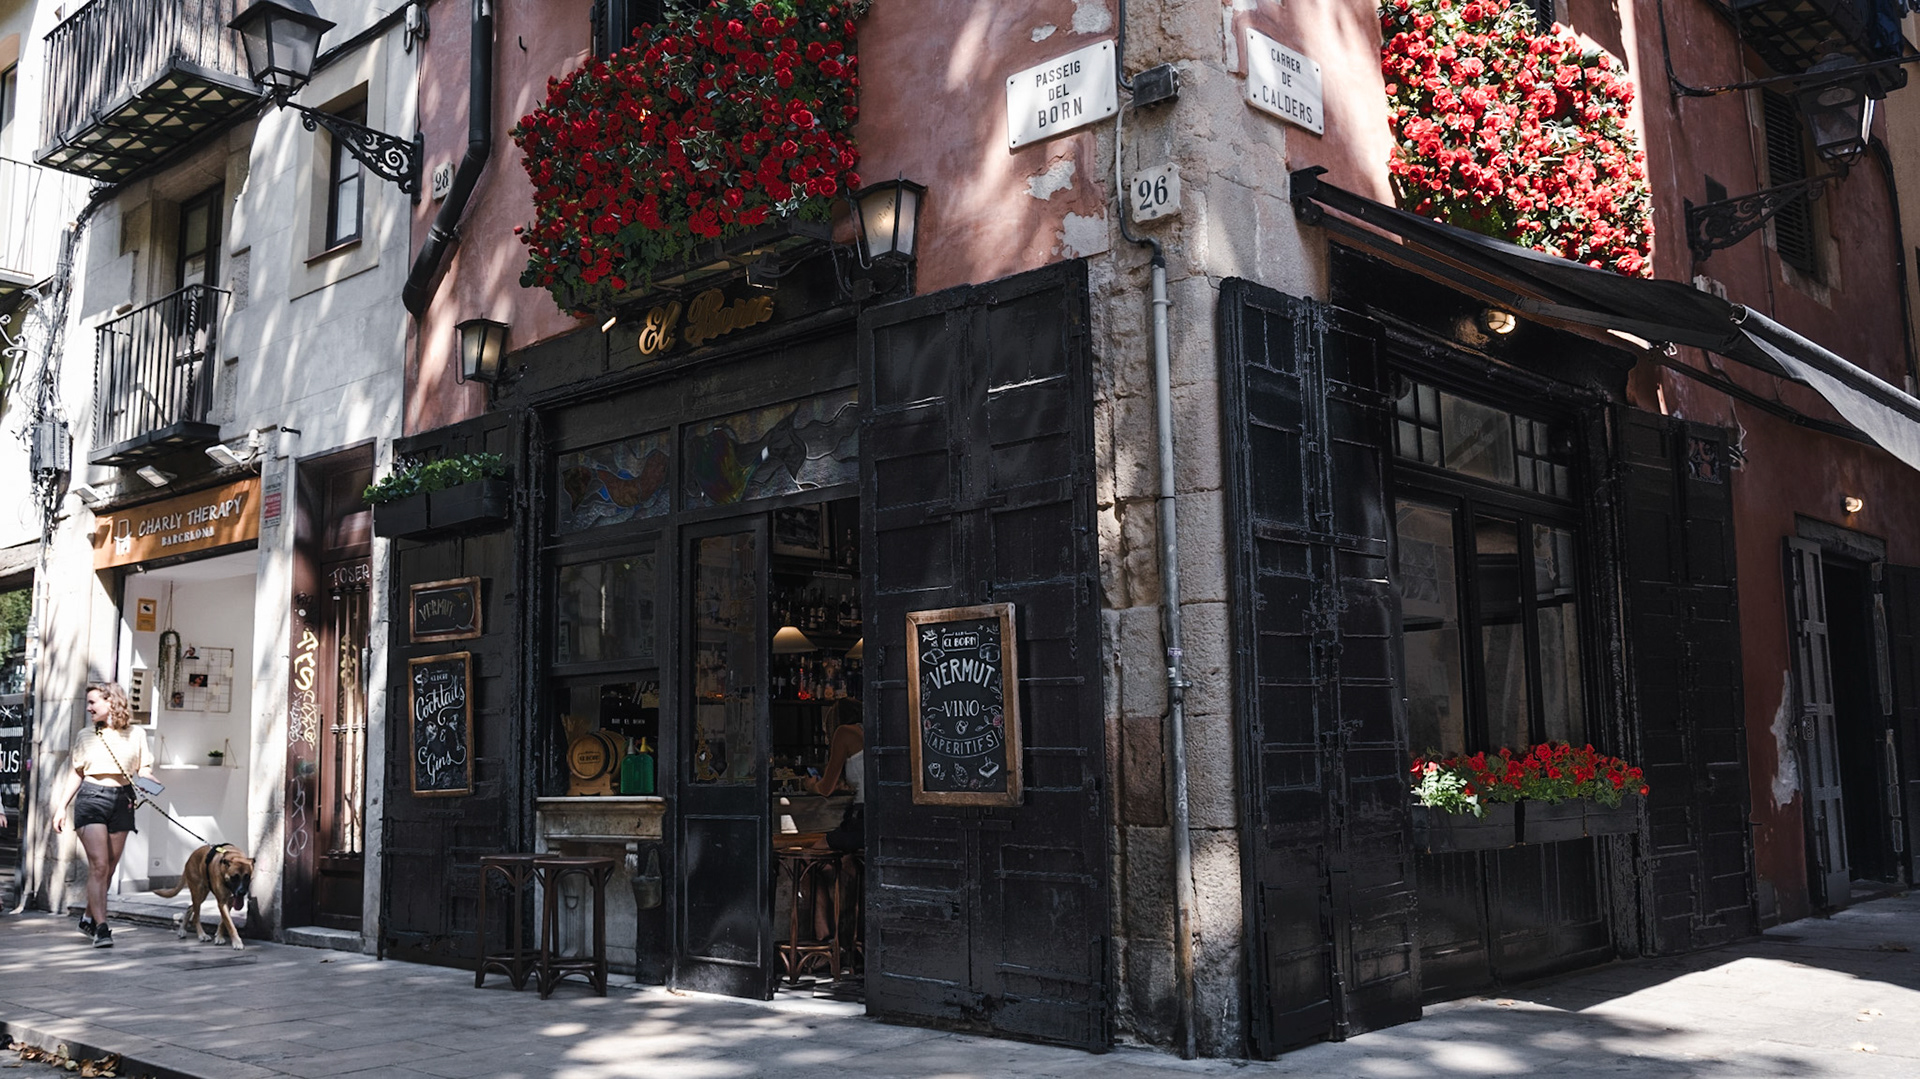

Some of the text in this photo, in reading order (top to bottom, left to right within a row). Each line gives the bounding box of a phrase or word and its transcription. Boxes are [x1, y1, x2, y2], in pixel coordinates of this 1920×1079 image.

[1035, 60, 1081, 88] PASSEIG
[1271, 48, 1301, 74] CARRER
[1048, 83, 1070, 102] DEL
[1281, 71, 1292, 88] DE
[1038, 96, 1082, 128] BORN
[1262, 85, 1313, 124] CALDERS
[435, 168, 449, 192] 28
[1138, 175, 1168, 211] 26
[638, 300, 682, 356] El
[138, 512, 182, 537] CHARLY
[186, 495, 242, 526] THERAPY
[161, 526, 215, 547] BARCELONA
[328, 563, 370, 584] TOSER
[953, 635, 977, 648] BORN
[929, 658, 995, 689] VERMUT
[416, 675, 465, 723] Cocktails
[943, 699, 980, 717] VINO
[931, 734, 994, 755] APERITIFS
[420, 750, 459, 785] Gins
